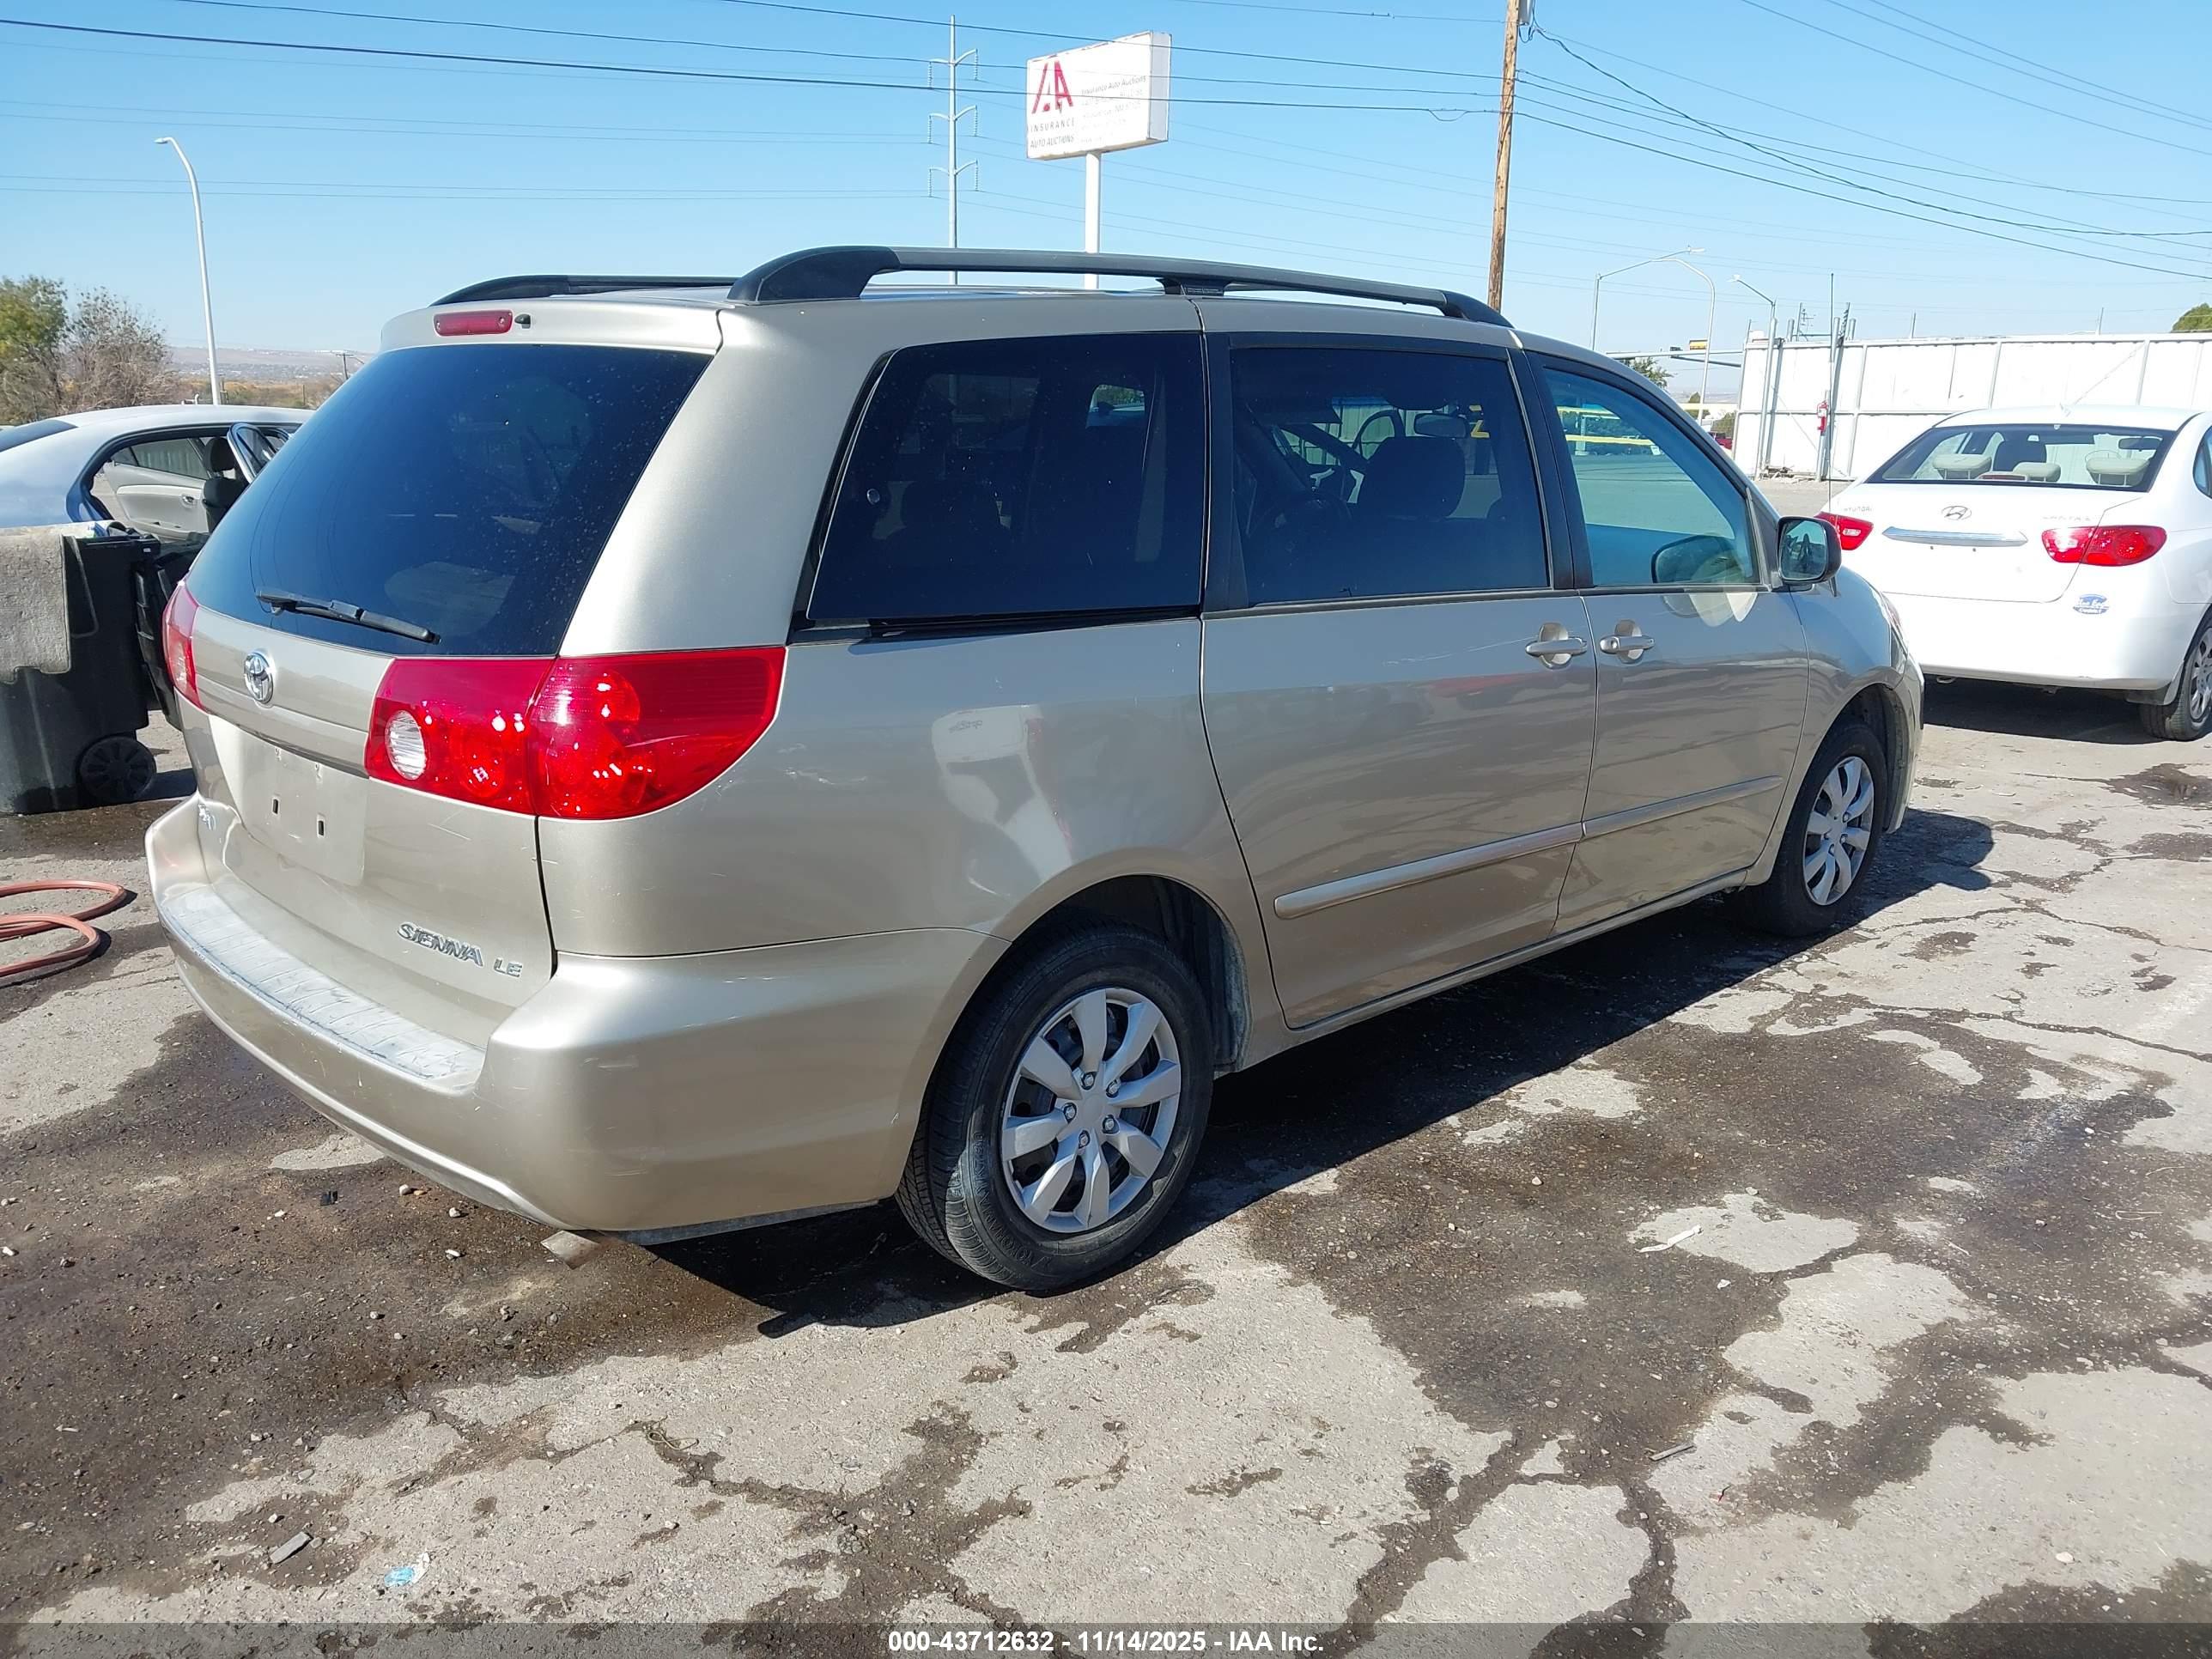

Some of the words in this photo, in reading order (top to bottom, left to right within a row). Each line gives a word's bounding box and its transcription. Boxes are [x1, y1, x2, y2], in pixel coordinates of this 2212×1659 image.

[1121, 75, 1146, 87] Auctions
[1030, 118, 1075, 133] INSURANCE
[1030, 137, 1046, 149] AUTO
[1046, 134, 1075, 147] AUCTIONS
[397, 922, 483, 967] SIENNA
[494, 957, 522, 977] LE
